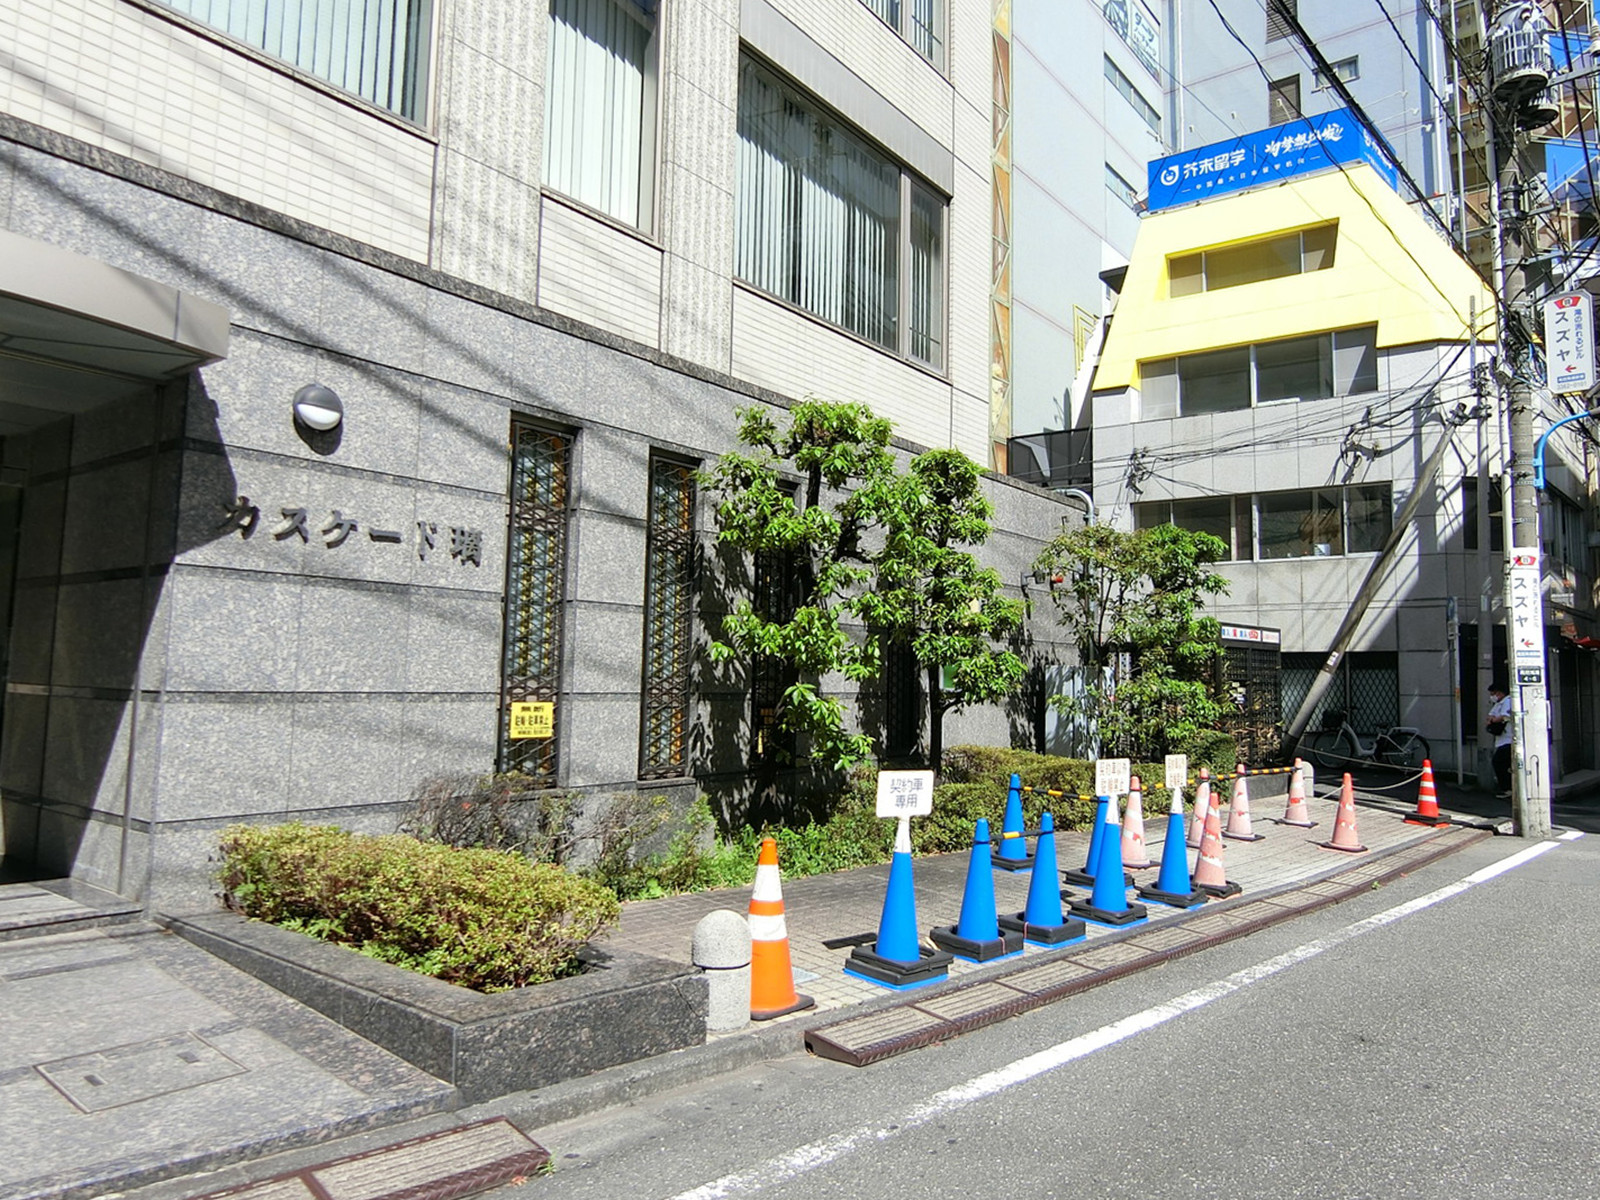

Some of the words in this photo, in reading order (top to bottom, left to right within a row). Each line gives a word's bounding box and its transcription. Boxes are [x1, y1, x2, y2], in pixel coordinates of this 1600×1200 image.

[1183, 148, 1246, 180] 芥末留学
[1555, 310, 1571, 362] スズヤ
[1513, 576, 1529, 628] スズヤ
[890, 778, 924, 794] 契約車
[895, 794, 918, 809] 専用
